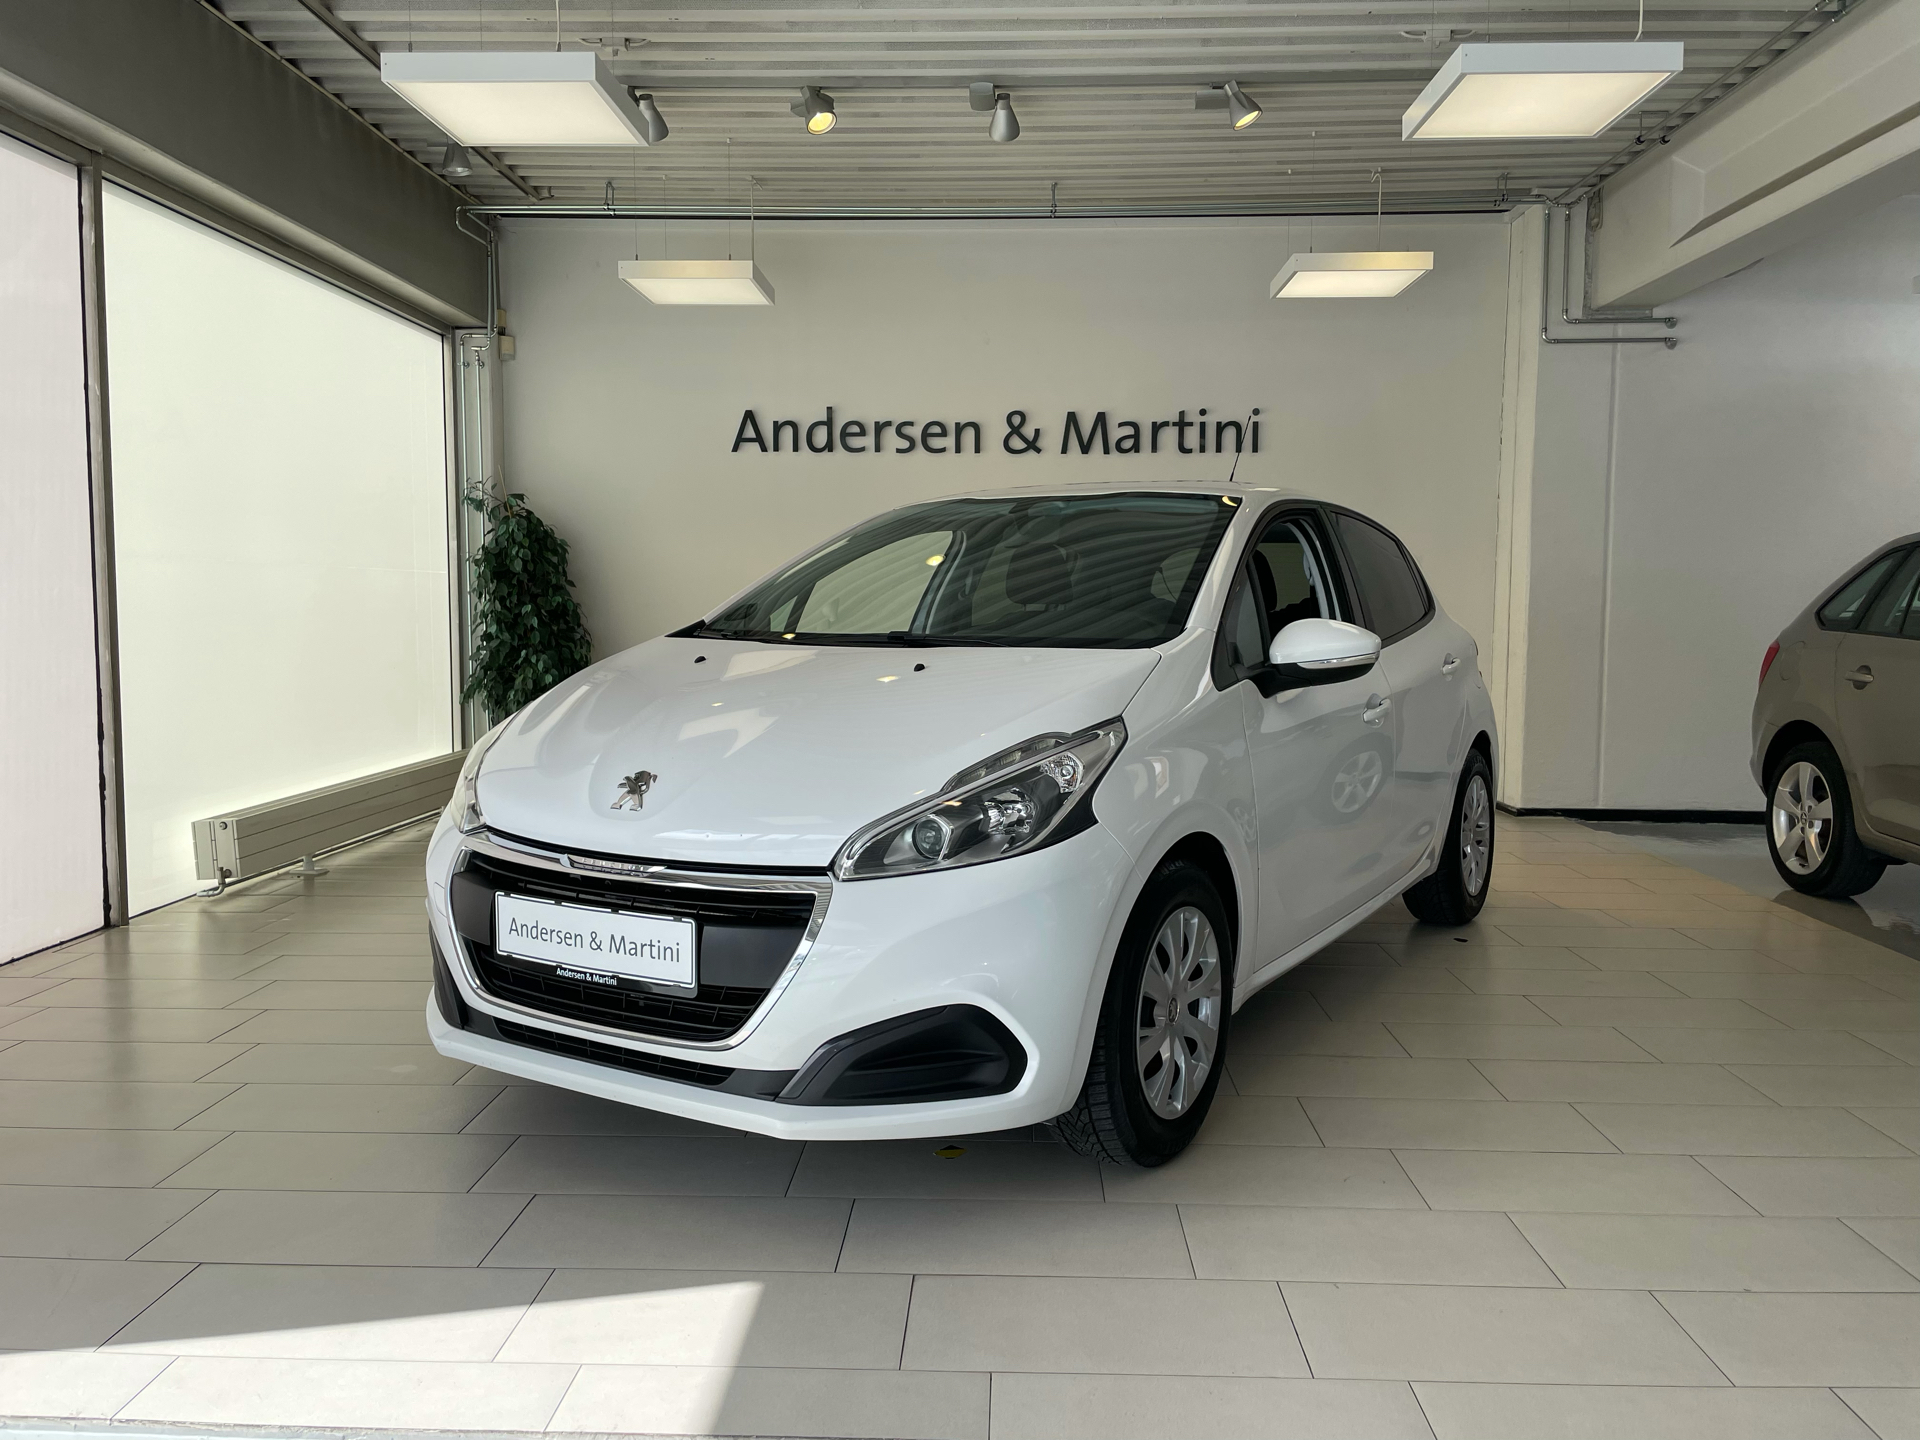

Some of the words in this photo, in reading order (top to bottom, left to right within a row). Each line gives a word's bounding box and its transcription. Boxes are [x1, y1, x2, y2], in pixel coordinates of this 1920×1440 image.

[731, 406, 982, 455] Andersen
[1002, 410, 1041, 455] &
[1060, 407, 1261, 455] Martini
[508, 917, 584, 949] Andersen
[589, 931, 603, 952] &
[609, 934, 680, 963] Martini
[557, 968, 584, 979] Andersen
[586, 973, 591, 981] &
[592, 975, 617, 986] Martini
